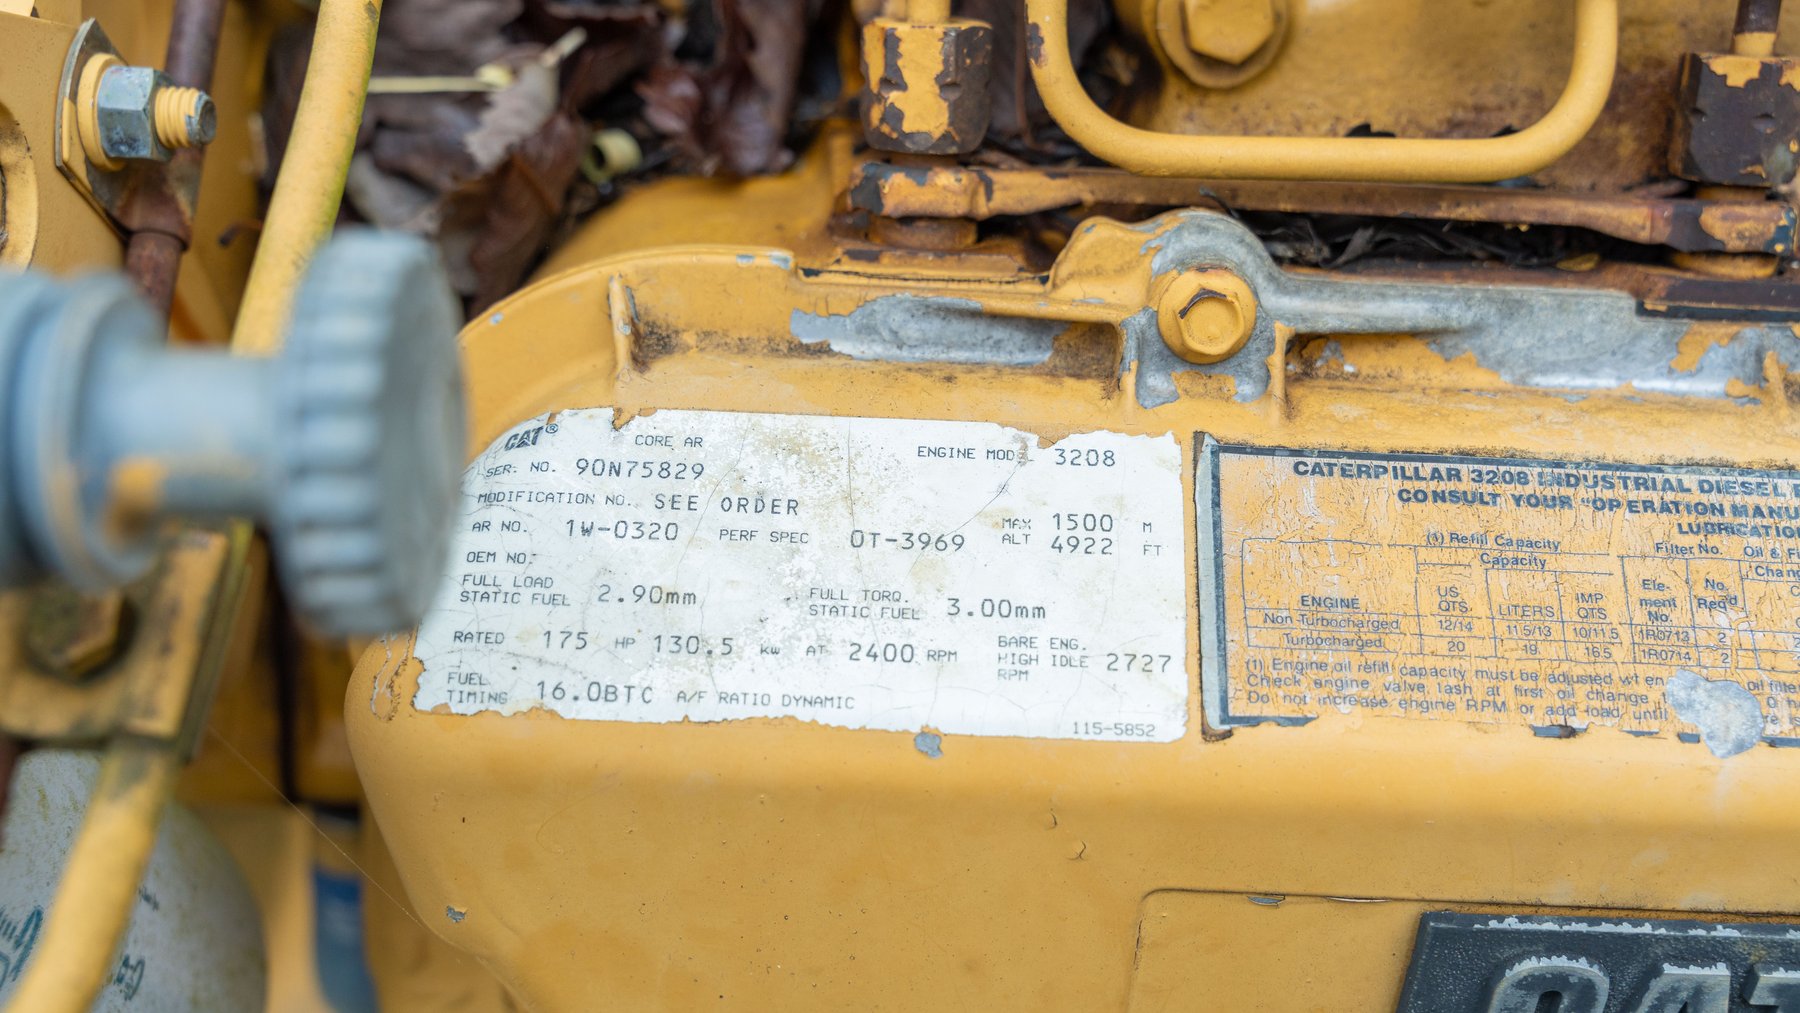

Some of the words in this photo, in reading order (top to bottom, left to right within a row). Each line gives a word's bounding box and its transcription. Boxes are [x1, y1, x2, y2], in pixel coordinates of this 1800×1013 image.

[635, 434, 673, 447] CORE
[684, 436, 703, 448] AR
[917, 446, 976, 460] ENGINE
[1055, 448, 1116, 468] 3208
[530, 461, 556, 473] NO.
[1293, 461, 1462, 483] CATERPILLAR
[1470, 469, 1530, 486] 3208
[1538, 472, 1692, 493] INDUSTRIAL
[1699, 480, 1786, 497] DIESEL
[478, 492, 595, 506] MODIFICATION
[605, 493, 632, 507] NO.
[654, 493, 698, 511] SEE
[721, 496, 799, 516] ORDER
[1398, 488, 1503, 507] CONSULT
[1511, 493, 1574, 510] YOUR
[472, 520, 491, 532] AR
[501, 520, 528, 533] NO.
[566, 519, 679, 541] 1W-0320
[1002, 518, 1031, 530] MAX
[1052, 513, 1114, 532] 1500
[1142, 522, 1152, 534] M
[1677, 522, 1800, 538] LUBRICATIO
[719, 529, 758, 542] PERF
[770, 530, 809, 545] SPEC
[1450, 533, 1488, 545] Refill
[1494, 535, 1561, 552] Capacity
[1002, 533, 1031, 545] ALT
[1051, 536, 1114, 555] 4922
[1142, 544, 1163, 557] FT
[1698, 543, 1723, 557] No.
[1744, 546, 1763, 557] Oil
[1770, 548, 1780, 559] &
[466, 551, 496, 564] OEM
[1480, 553, 1547, 569] Capacity
[462, 575, 502, 588] FULL
[513, 575, 554, 589] LOAD
[1642, 579, 1670, 591] Ele-
[1705, 578, 1729, 591] No.
[460, 590, 521, 605] STATIC
[531, 593, 571, 607] FUEL
[597, 584, 697, 606] 2.90mm
[810, 588, 849, 601] FULL
[862, 589, 909, 604] TORQ.
[1437, 586, 1459, 597] US
[1577, 593, 1604, 604] IMP
[947, 597, 1046, 620] 3.00mm
[1300, 595, 1360, 610] ENGINE
[1640, 598, 1677, 608] ment
[809, 605, 871, 619] STATIC
[880, 606, 921, 620] FUEL
[1498, 604, 1555, 617] LITERS
[1577, 607, 1607, 620] QTS
[1648, 611, 1672, 623] No.
[1438, 620, 1473, 632] 12/14
[998, 636, 1038, 649] BARE
[1050, 638, 1088, 651] ENG.
[1283, 633, 1382, 650] Turbocharged
[1718, 632, 1726, 643] 2
[453, 631, 505, 645] RATED
[543, 630, 589, 650] 175
[615, 637, 636, 649] HP
[654, 634, 734, 656] 130.5
[849, 642, 915, 663] 2400
[927, 650, 958, 662] RPM
[1447, 641, 1465, 652] 20
[1585, 647, 1612, 658] 16.5
[998, 653, 1039, 666] HIGH
[1052, 654, 1089, 669] IDLE
[1106, 653, 1172, 674] 2727
[1721, 653, 1730, 664] 2
[448, 672, 489, 686] FUEL
[1273, 659, 1328, 674] Engine
[1335, 660, 1351, 672] oil
[1400, 664, 1466, 681] capacity
[1475, 668, 1514, 682] must
[1521, 669, 1538, 682] be
[1548, 671, 1612, 687] adjusted
[447, 690, 508, 705] TIMING
[537, 680, 652, 705] 16.0BTC
[676, 691, 706, 704] A/F
[719, 692, 770, 706] RATIO
[782, 693, 855, 709] DYNAMIC
[1247, 674, 1301, 688] Check
[1313, 678, 1370, 692] engine
[1383, 679, 1426, 693] valve
[1438, 683, 1472, 695] lash
[1486, 685, 1502, 697] at
[1515, 685, 1544, 698] first
[1557, 687, 1575, 700] oil
[1586, 689, 1648, 706] change
[1248, 692, 1269, 704] Do
[1283, 693, 1308, 704] not
[1318, 694, 1388, 711] increase
[1398, 699, 1455, 713] engine
[1467, 701, 1506, 715] RPM
[1520, 705, 1534, 715] or
[1546, 704, 1576, 717] add
[1633, 708, 1668, 721] until
[1073, 721, 1155, 738] 115-5852
